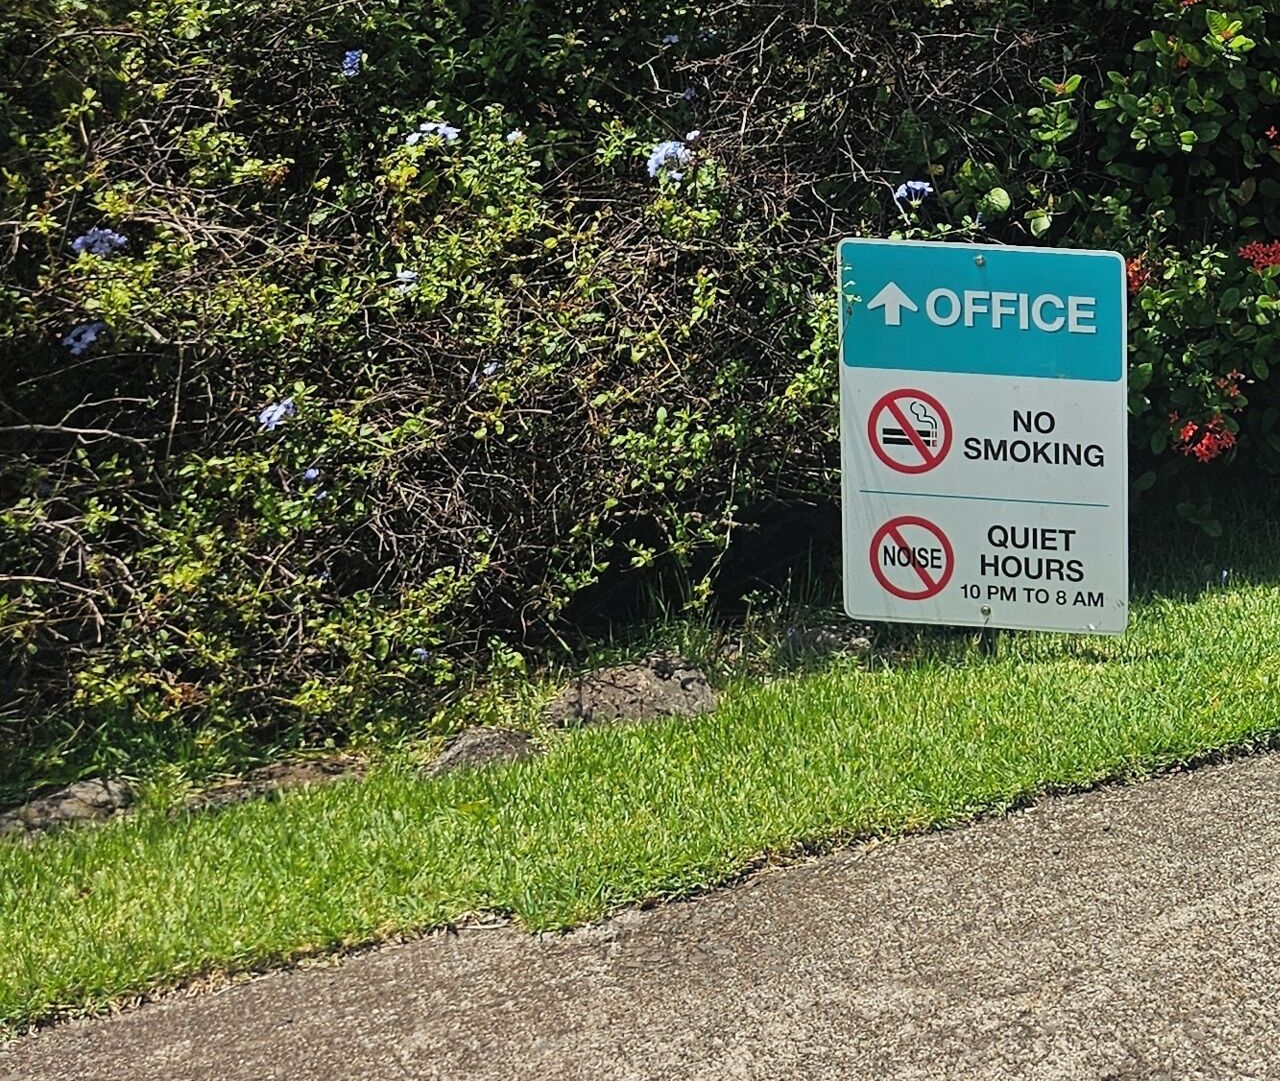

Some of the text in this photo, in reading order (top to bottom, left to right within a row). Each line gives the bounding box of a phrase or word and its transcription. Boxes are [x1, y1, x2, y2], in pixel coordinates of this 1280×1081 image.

[926, 287, 1097, 334] OFFICE
[1013, 410, 1055, 434] NO
[963, 437, 1105, 467] SMOKING
[987, 525, 1076, 551] QUIET
[883, 545, 942, 569] NOISE
[980, 554, 1084, 582] HOURS
[960, 584, 1104, 607] 10 PM TO 8 AM
